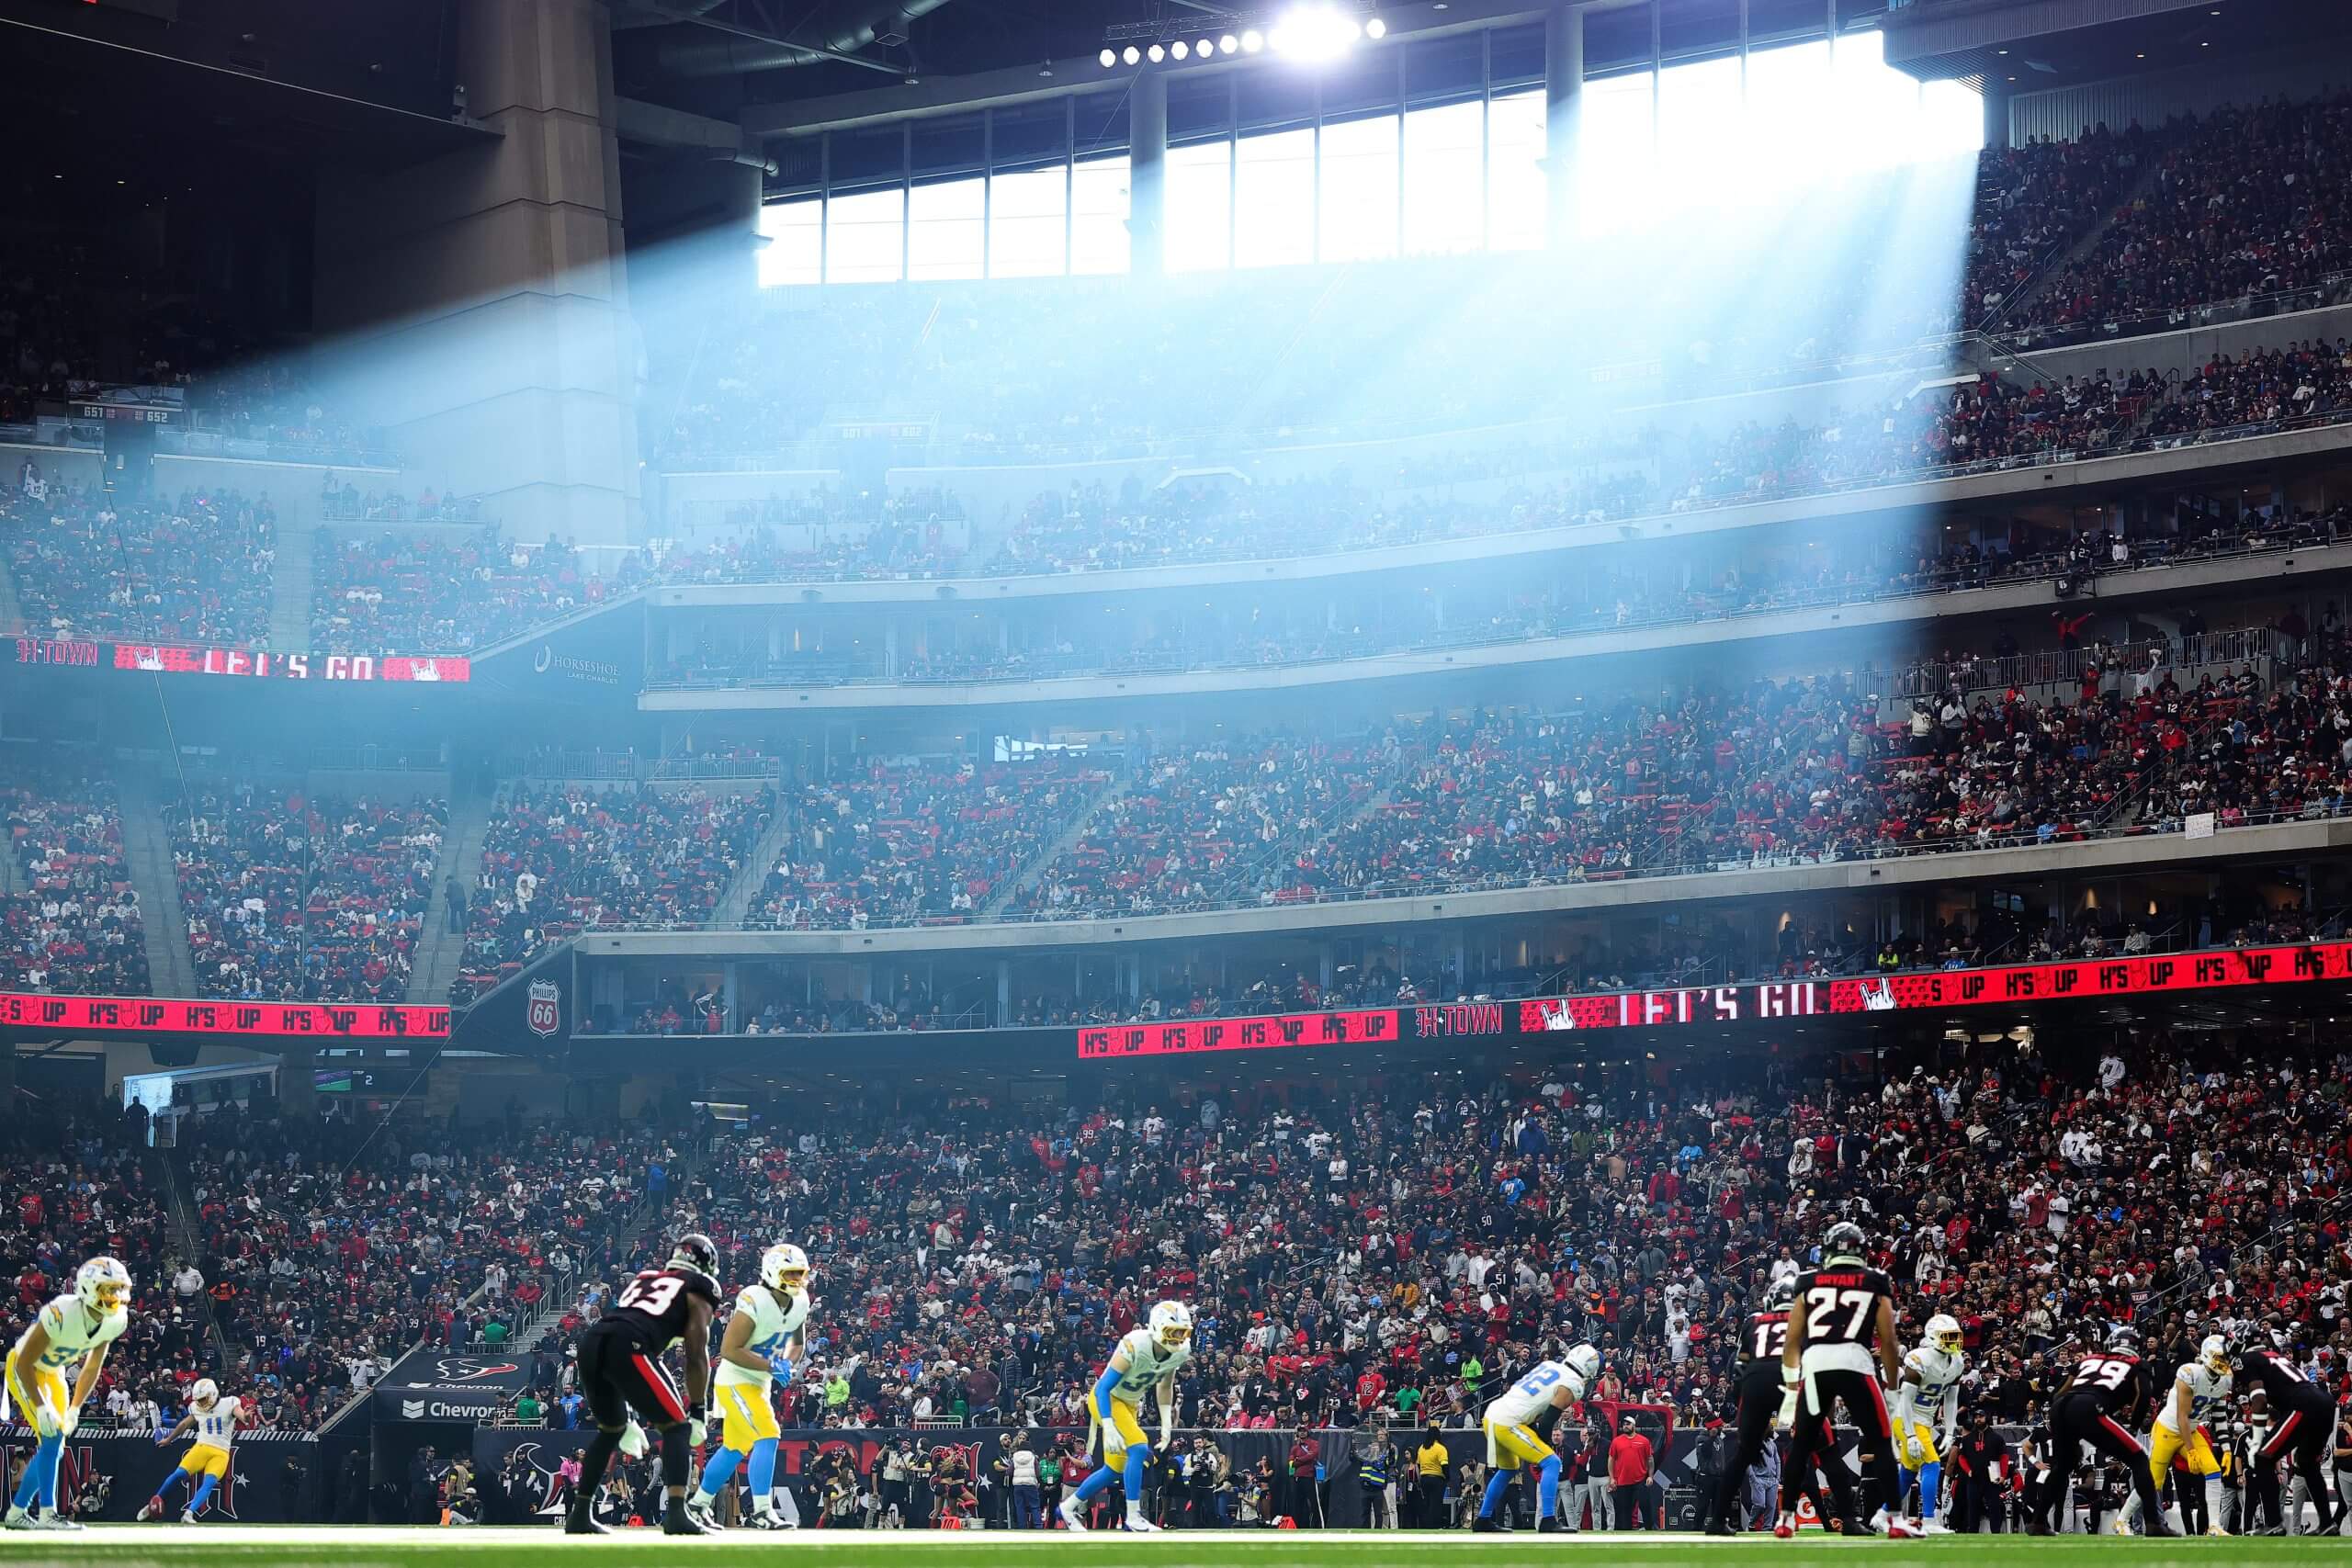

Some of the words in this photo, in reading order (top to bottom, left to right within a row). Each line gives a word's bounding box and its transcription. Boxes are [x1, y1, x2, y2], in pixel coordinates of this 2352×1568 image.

[85, 407, 103, 418] 651
[147, 412, 167, 423] 652
[554, 655, 618, 675] HORSESHOE
[567, 671, 586, 680] LAKE
[587, 674, 618, 684] CHARLES
[2167, 703, 2178, 714] 12
[2196, 958, 2224, 983] H'S
[2247, 954, 2272, 979] UP
[2099, 965, 2128, 989] H'S
[2150, 962, 2174, 986] UP
[1962, 976, 1984, 999] UP
[2007, 972, 2033, 997] H'S
[2054, 969, 2078, 993] UP
[532, 987, 556, 1000] PHILLIPS
[42, 1001, 67, 1022] UP
[89, 1003, 119, 1024] H'S
[140, 1005, 164, 1026] UP
[533, 1003, 553, 1025] 66
[187, 1006, 215, 1028] H'S
[236, 1009, 261, 1030] UP
[283, 1010, 311, 1031] H'S
[1365, 1015, 1385, 1037] UP
[1162, 1027, 1185, 1049] H'S
[1204, 1025, 1224, 1046] UP
[1241, 1022, 1265, 1043] H'S
[1085, 1032, 1107, 1054] H'S
[1125, 1030, 1145, 1051] UP
[365, 1075, 373, 1086] 2
[1630, 1090, 1636, 1100] 7
[1461, 1106, 1469, 1116] 12
[2291, 1106, 2297, 1117] 7
[1082, 1129, 1093, 1139] 99
[1148, 1123, 1156, 1133] 7
[2071, 1141, 2078, 1151] 7
[1184, 1173, 1191, 1182] 15
[1451, 1208, 1457, 1218] 7
[105, 1219, 115, 1230] 51
[1481, 1214, 1492, 1226] 50
[1904, 1249, 1911, 1260] 7
[1881, 1256, 1886, 1267] 7
[1162, 1277, 1174, 1286] 24
[1495, 1273, 1506, 1284] 51
[1815, 1273, 1865, 1286] BRYANT
[617, 1277, 684, 1316] 63
[1119, 1308, 1125, 1319] 7
[1806, 1287, 1874, 1340] 27
[409, 1318, 419, 1329] 99
[255, 1336, 266, 1347] 19
[353, 1366, 359, 1377] 7
[2072, 1359, 2132, 1391] 29
[1255, 1384, 1261, 1397] 7
[1363, 1382, 1374, 1395] 12
[118, 1399, 125, 1411] 7
[790, 1396, 797, 1407] 7
[206, 1417, 222, 1435] 11
